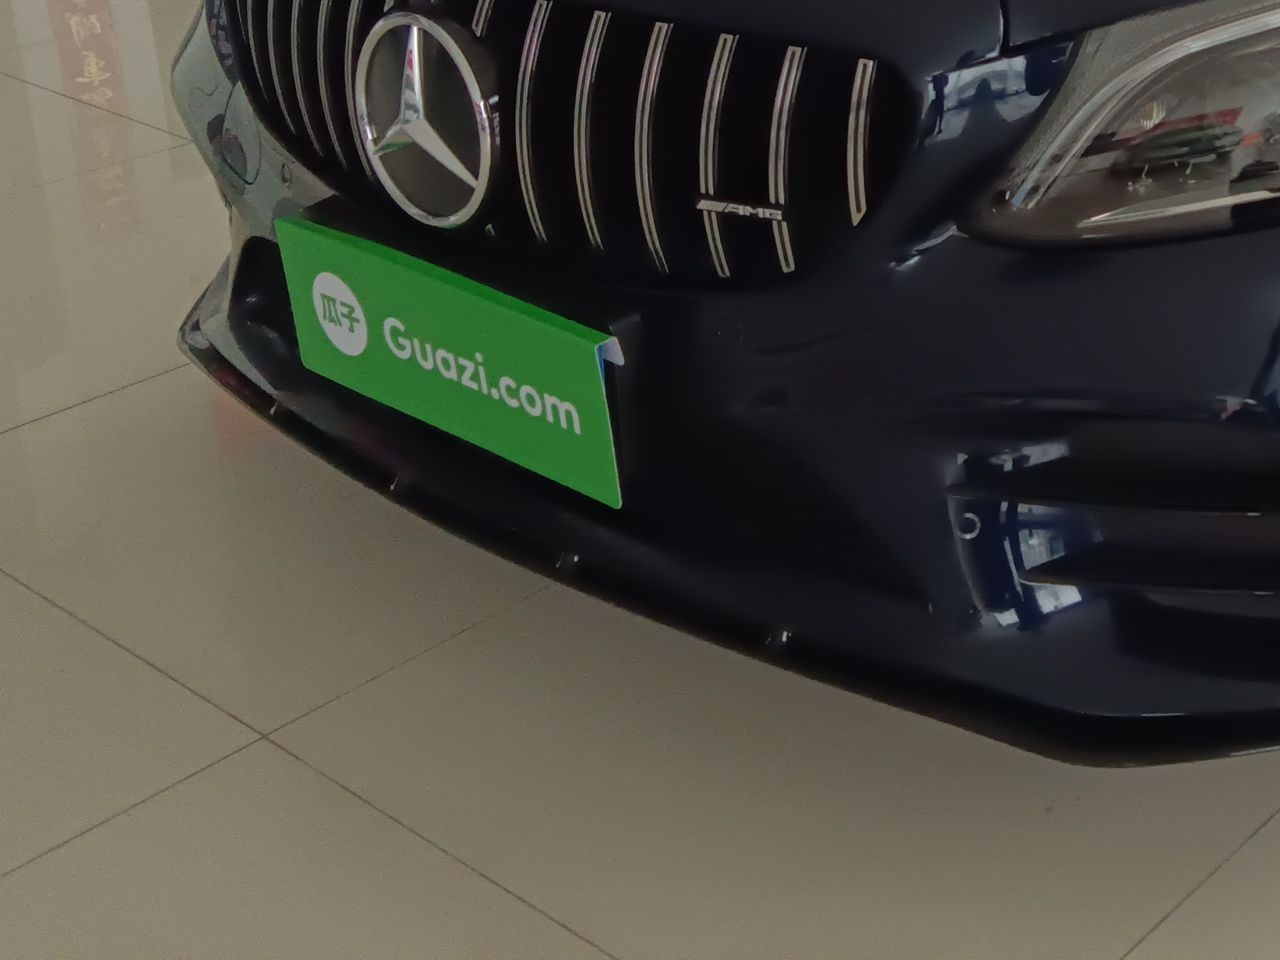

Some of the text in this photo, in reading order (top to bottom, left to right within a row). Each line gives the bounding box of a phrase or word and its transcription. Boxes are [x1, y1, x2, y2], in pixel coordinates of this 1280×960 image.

[723, 202, 783, 221] AMG
[319, 292, 361, 334] 瓜子
[383, 316, 583, 436] Guazi.com
